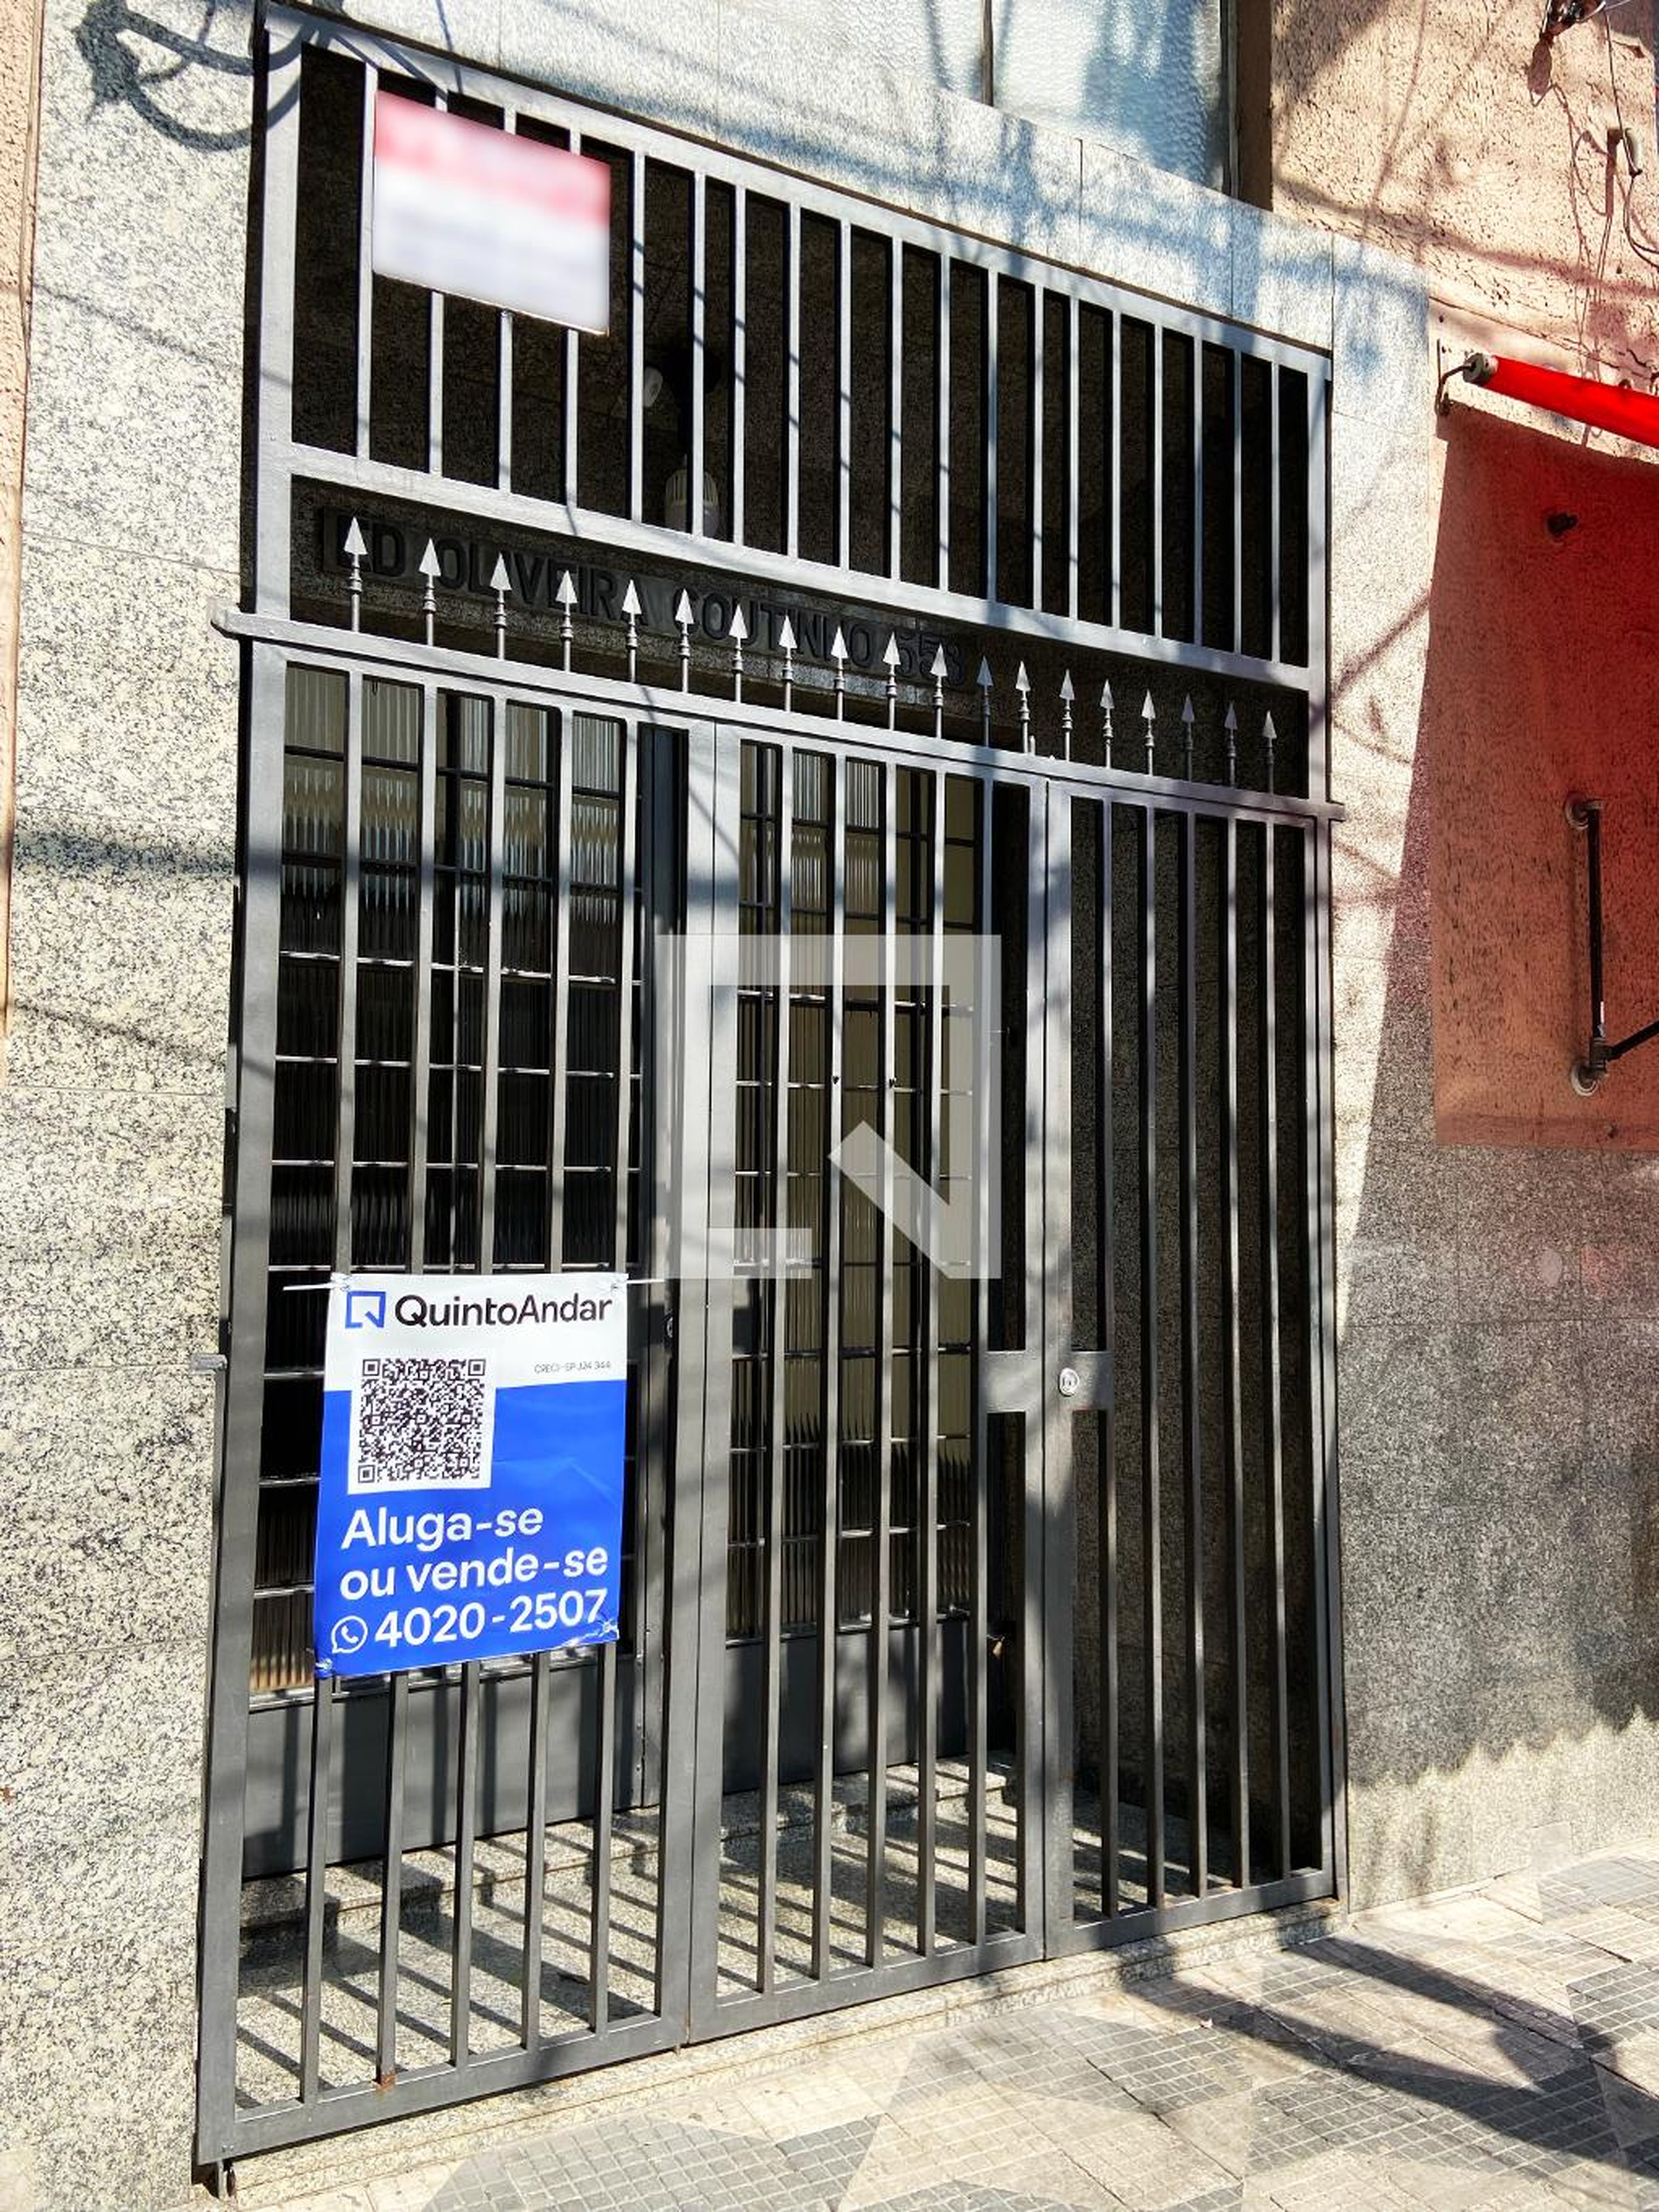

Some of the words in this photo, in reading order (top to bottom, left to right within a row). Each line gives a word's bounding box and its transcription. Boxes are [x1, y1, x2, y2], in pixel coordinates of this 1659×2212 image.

[434, 538, 648, 627] OLVEIRA
[673, 586, 874, 668] COUTNHO
[395, 1293, 613, 1328] QuintoAndar
[340, 1506, 543, 1552] Aluga-se
[340, 1569, 395, 1601] ou
[407, 1547, 608, 1592] vende-se
[375, 1588, 608, 1647] 4020-2507
